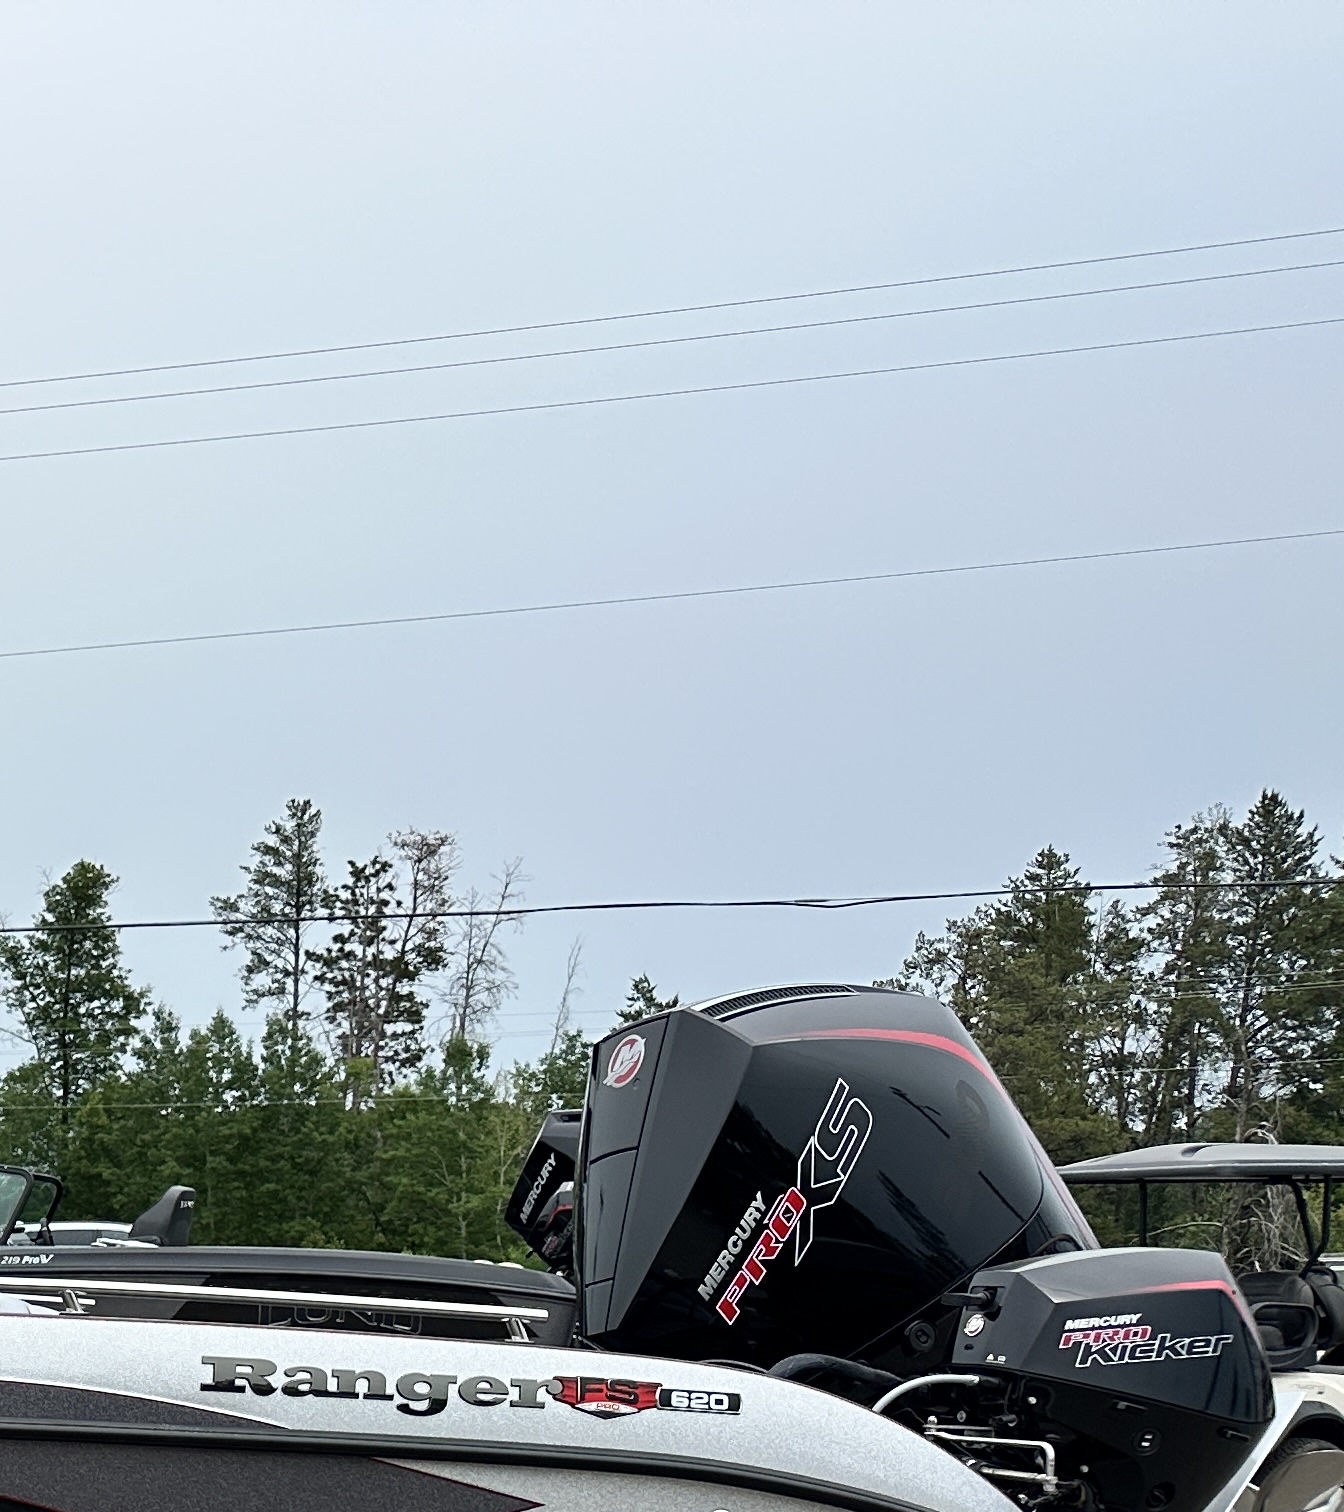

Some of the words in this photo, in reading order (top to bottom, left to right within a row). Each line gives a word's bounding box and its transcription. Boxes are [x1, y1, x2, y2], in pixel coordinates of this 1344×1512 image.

[519, 1151, 558, 1225] MERCURY
[0, 1255, 21, 1265] 219
[696, 1190, 768, 1303] MERCURY
[715, 1186, 807, 1325] PRO
[1059, 1325, 1153, 1349] PRO
[1064, 1313, 1143, 1330] MERCURY
[1074, 1333, 1234, 1369] Kicker
[200, 1355, 564, 1417] Ranger
[577, 1375, 640, 1405] FS
[670, 1390, 730, 1411] 620
[595, 1402, 621, 1411] PRO
